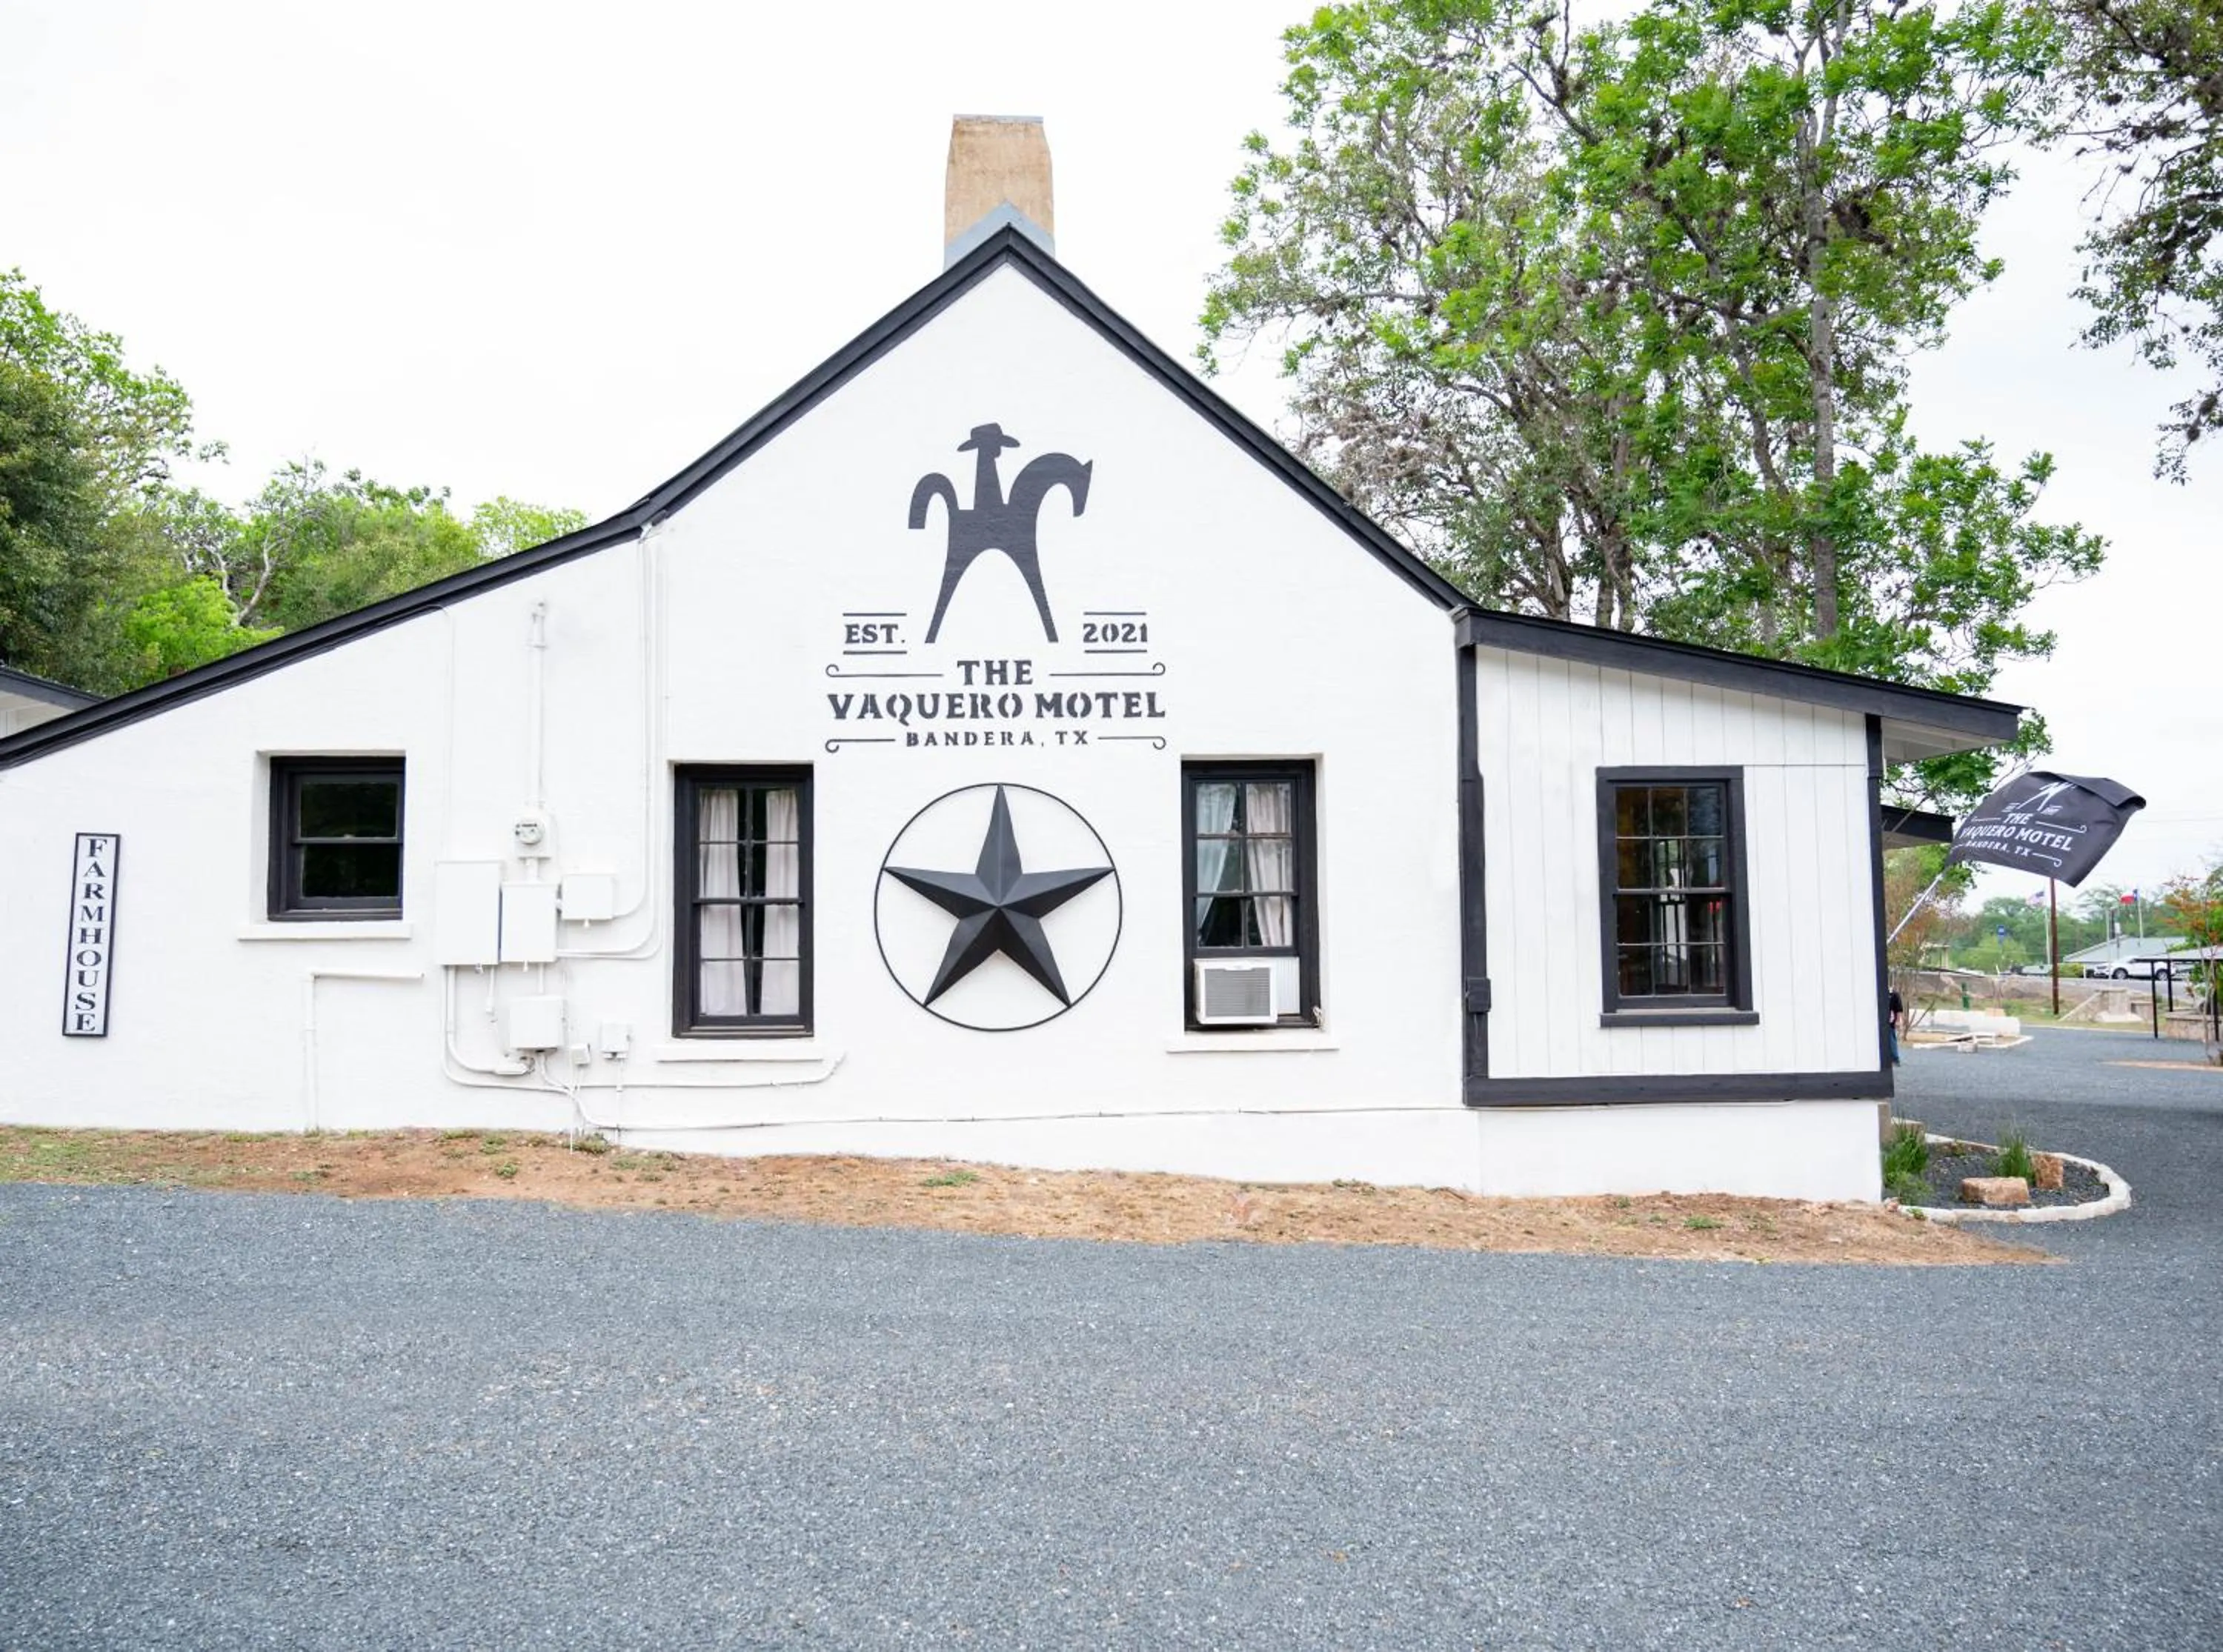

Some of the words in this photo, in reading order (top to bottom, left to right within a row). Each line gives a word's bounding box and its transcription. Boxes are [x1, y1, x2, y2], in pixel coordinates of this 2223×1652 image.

[845, 623, 906, 645] EST.
[1083, 622, 1148, 643] 2021
[957, 659, 1033, 686] THE
[827, 693, 1023, 726] VAQUERO
[1034, 692, 1166, 719] MOTEL
[906, 731, 1044, 747] BANDERA,
[1054, 730, 1088, 745] TX
[2003, 813, 2033, 825] THE
[2014, 827, 2073, 851] MOTEL
[2015, 845, 2033, 857] TX
[74, 838, 107, 1031] FARMHOUSE
